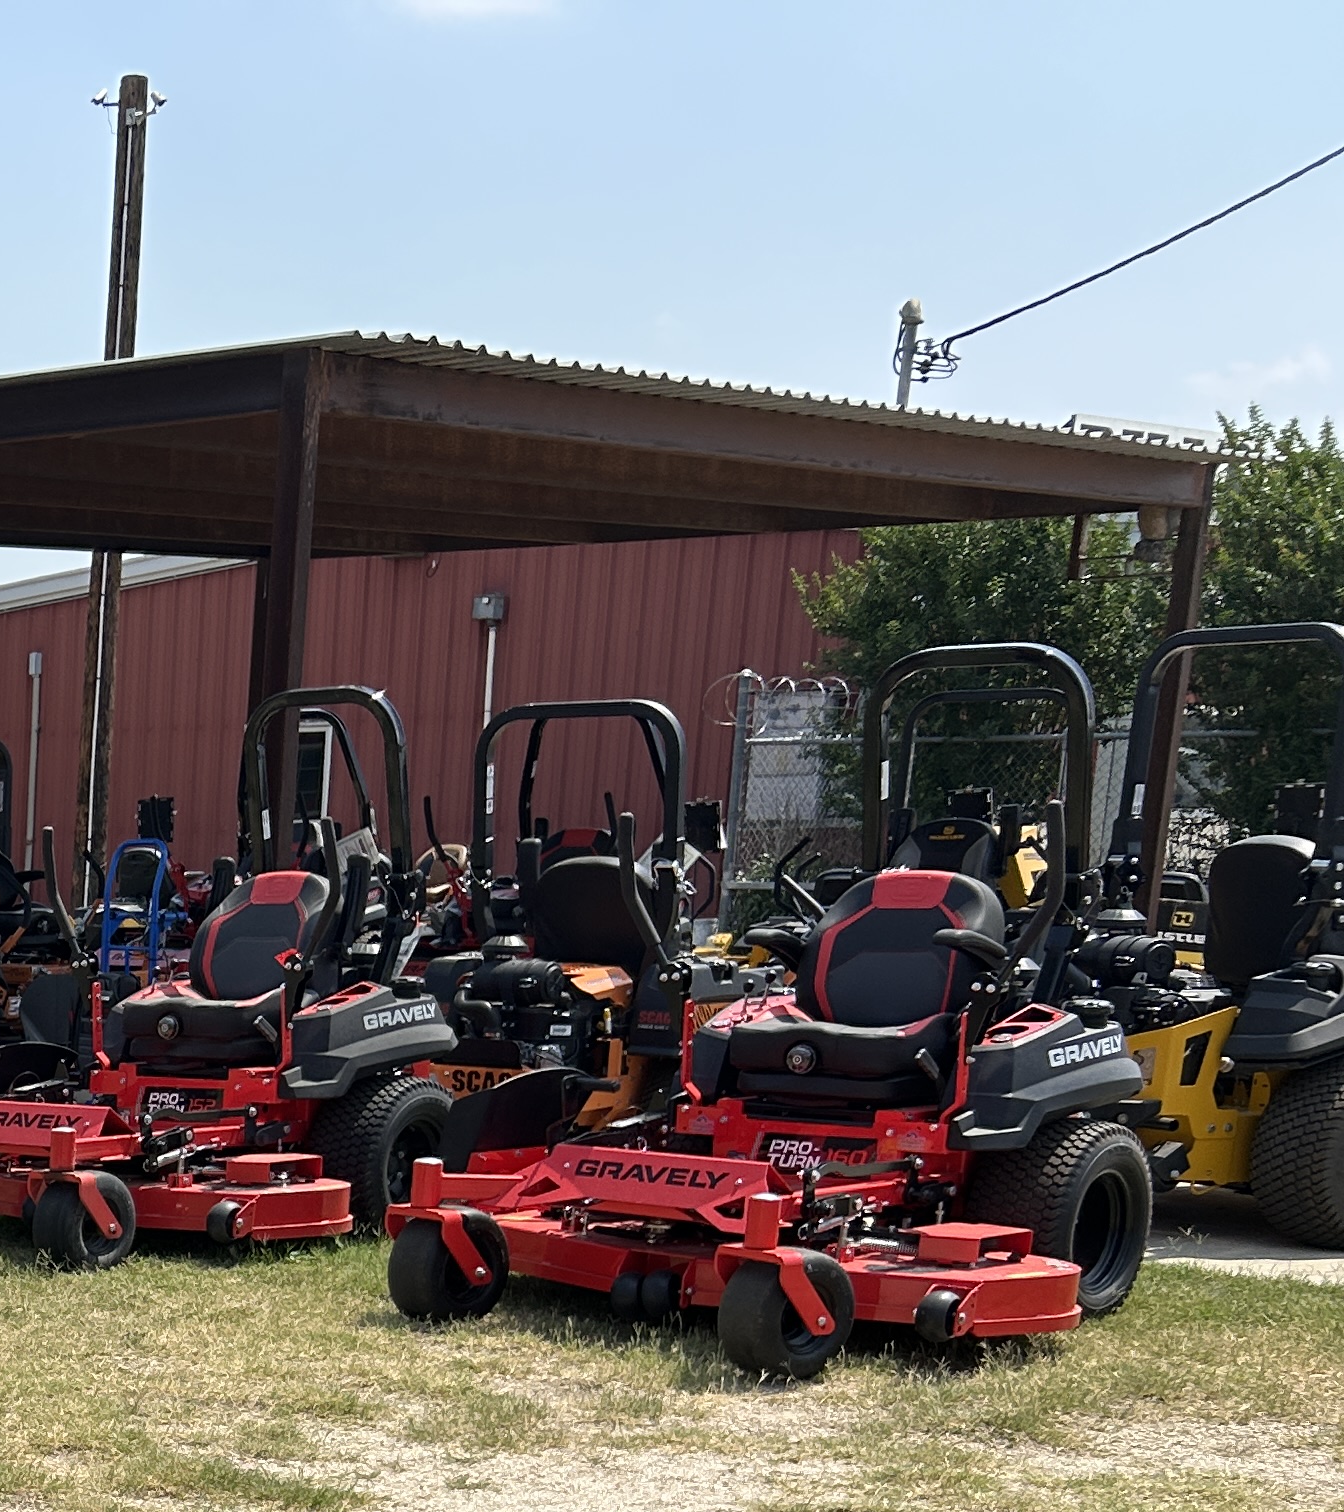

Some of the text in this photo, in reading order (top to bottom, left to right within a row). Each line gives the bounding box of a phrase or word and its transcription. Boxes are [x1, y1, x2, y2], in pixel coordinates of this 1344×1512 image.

[363, 1002, 436, 1031] GRAVELY
[1048, 1034, 1122, 1068] GRAVELY
[767, 1153, 821, 1168] TURN
[769, 1139, 821, 1154] PRO-
[575, 1159, 730, 1189] GRAVELY
